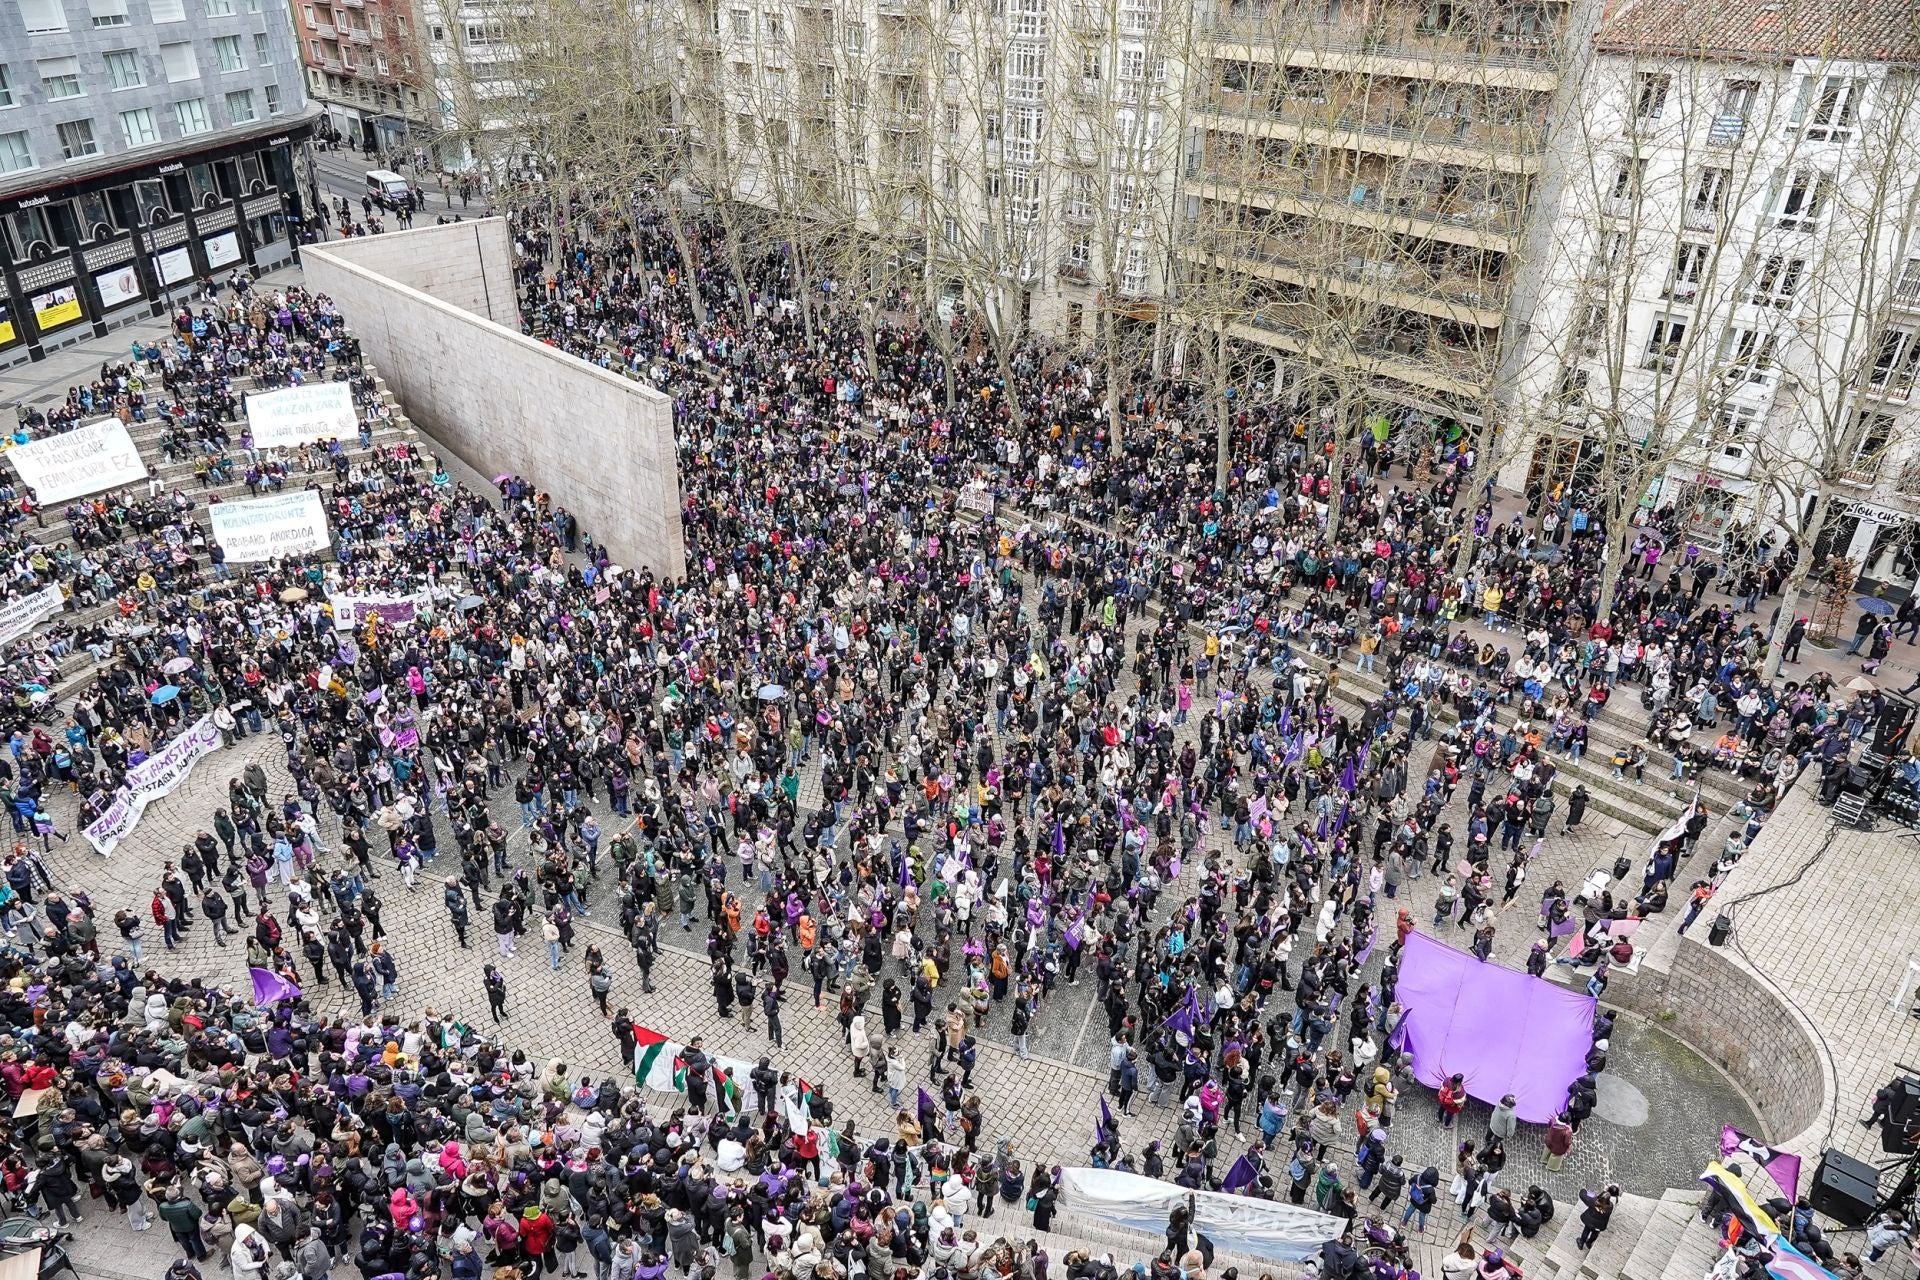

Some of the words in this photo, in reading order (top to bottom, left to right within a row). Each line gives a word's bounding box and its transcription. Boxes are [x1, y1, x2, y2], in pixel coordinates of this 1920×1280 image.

[269, 136, 290, 146] kutxabank
[159, 162, 184, 173] kutxabank
[18, 195, 50, 208] kutxabank
[14, 445, 44, 460] SEXU
[110, 452, 136, 472] EZ
[12, 603, 25, 613] nos
